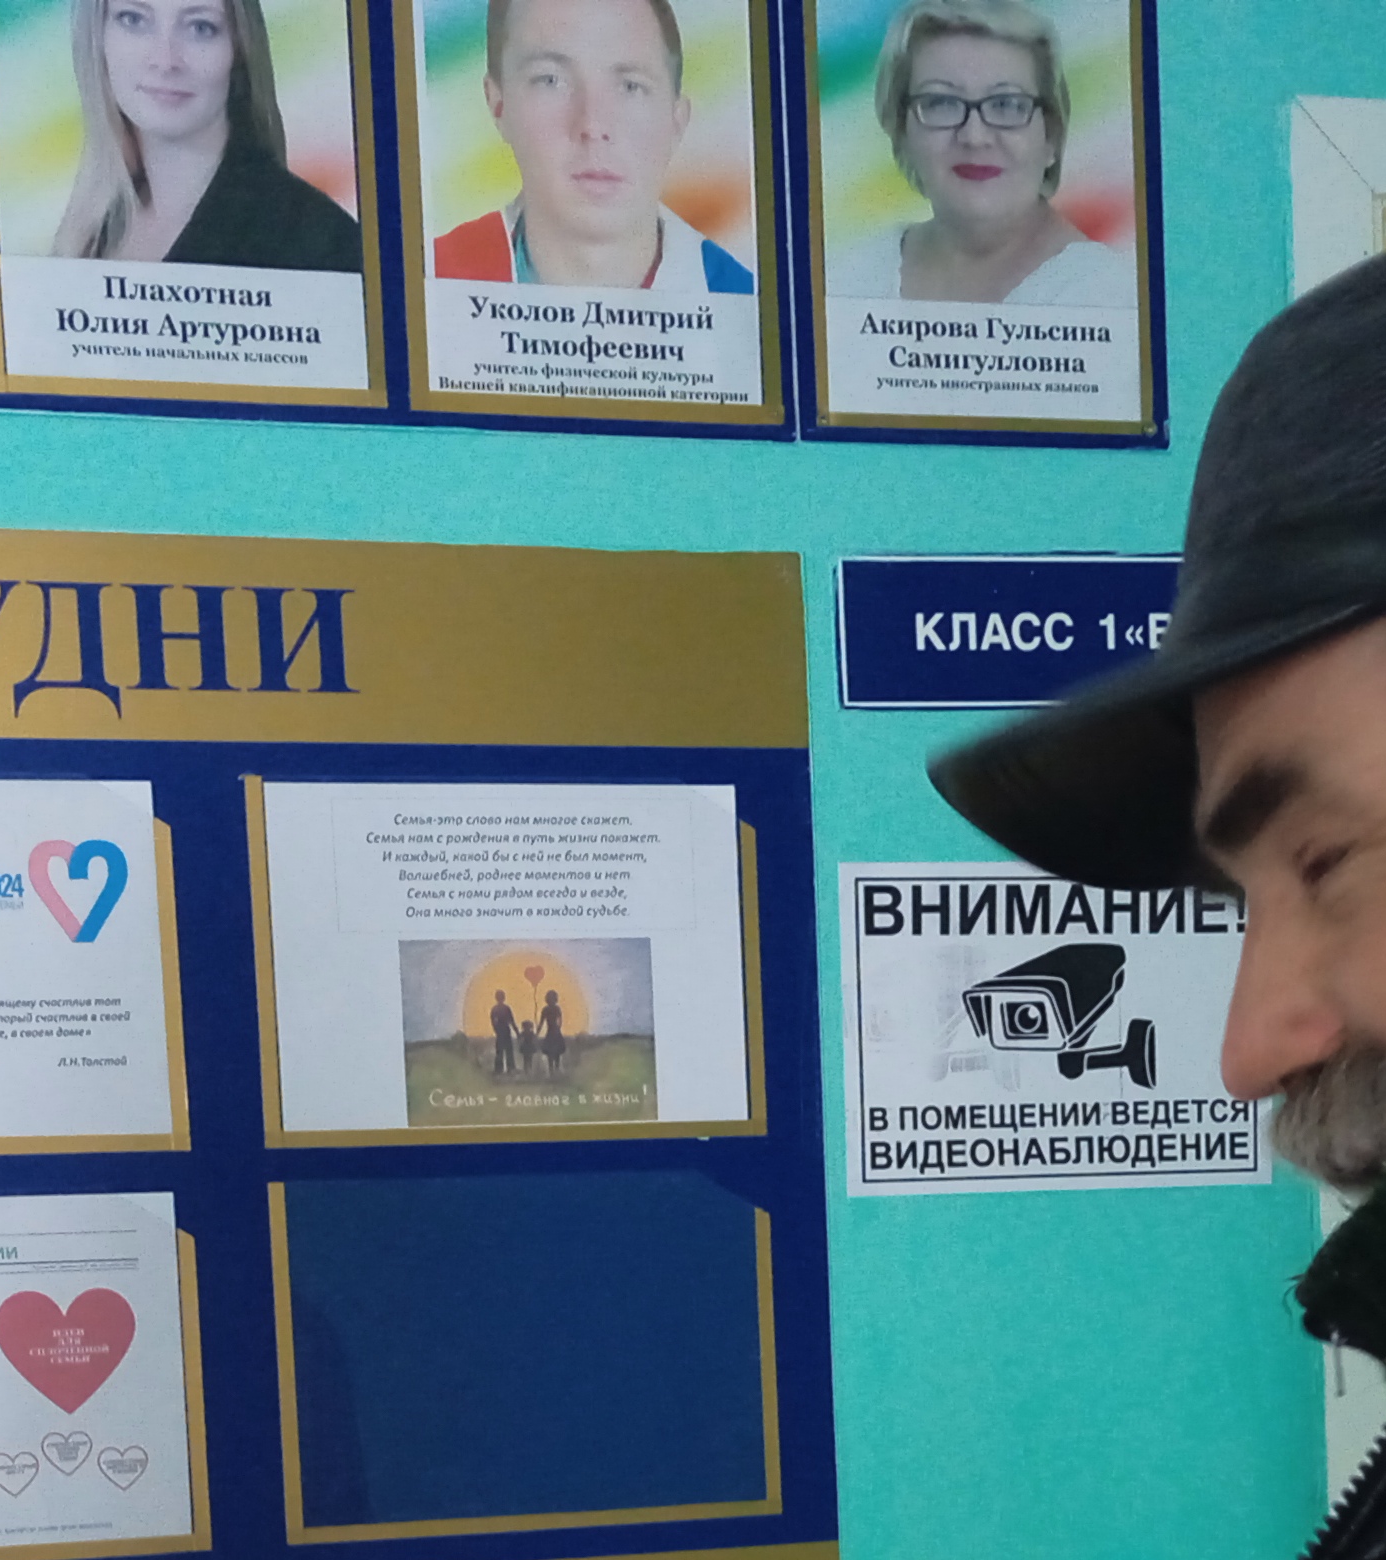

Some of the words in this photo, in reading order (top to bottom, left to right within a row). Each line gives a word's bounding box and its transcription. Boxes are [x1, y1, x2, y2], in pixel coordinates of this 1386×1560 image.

[103, 275, 272, 307] Плахотная
[469, 296, 575, 323] Уколов
[582, 302, 713, 333] Дмитрий
[56, 308, 149, 335] Юлия
[158, 313, 321, 345] Артуровна
[860, 313, 978, 342] Акирова
[986, 317, 1111, 344] Гульсина
[72, 343, 141, 357] учитель
[146, 347, 239, 361] начальных
[244, 351, 308, 364] классов
[502, 331, 684, 363] Тимофеевич
[889, 346, 1085, 375] Самигулловна
[474, 363, 538, 377] учитель
[542, 365, 637, 381] физической
[642, 371, 713, 385] культуры
[439, 376, 504, 391] Высшей
[509, 381, 665, 400] квалификационной
[670, 390, 748, 404] категории
[877, 377, 936, 390] учитель
[941, 378, 1040, 394] иностранных
[1045, 383, 1098, 394] языков
[915, 612, 1074, 652] КЛАСС
[466, 815, 501, 825] слово
[505, 816, 529, 824] нам
[533, 816, 577, 826] многое
[581, 816, 632, 826] скажет.
[367, 833, 404, 843] Семья
[408, 835, 433, 843] нам
[447, 832, 509, 845] рождения
[523, 835, 554, 846] путь
[558, 835, 597, 843] жизни
[382, 852, 392, 862] И
[395, 851, 449, 864] каждый,
[453, 850, 488, 862] какой
[493, 851, 509, 862] бы
[522, 850, 543, 862] ней
[547, 853, 561, 861] не
[565, 851, 588, 861] был
[592, 853, 647, 863] момент,
[399, 869, 474, 882] Волшебней,
[478, 870, 521, 882] роднее
[525, 871, 590, 880] моментов
[605, 871, 630, 880] нет
[407, 888, 445, 899] Семья
[458, 889, 490, 899] нами
[494, 887, 533, 901] рядом
[537, 887, 576, 899] всегда
[591, 887, 627, 900] везде,
[406, 907, 431, 918] Она
[435, 908, 472, 918] много
[477, 908, 522, 917] значит
[537, 905, 582, 918] каждой
[587, 906, 630, 919] судьбе.
[863, 885, 1248, 936] ВНИМАНИЕ!
[39, 999, 92, 1007] счастлив
[95, 998, 121, 1006] тот
[35, 1014, 88, 1023] счастлив
[100, 1011, 130, 1022] своей
[429, 1088, 484, 1107] Семья
[869, 1107, 888, 1132] В
[898, 1102, 1102, 1135] ПОМЕЩЕНИИ
[1111, 1099, 1250, 1128] ВЕДЕТСЯ
[869, 1132, 1250, 1174] ВИДЕОНАБЛЮДЕНИЕ
